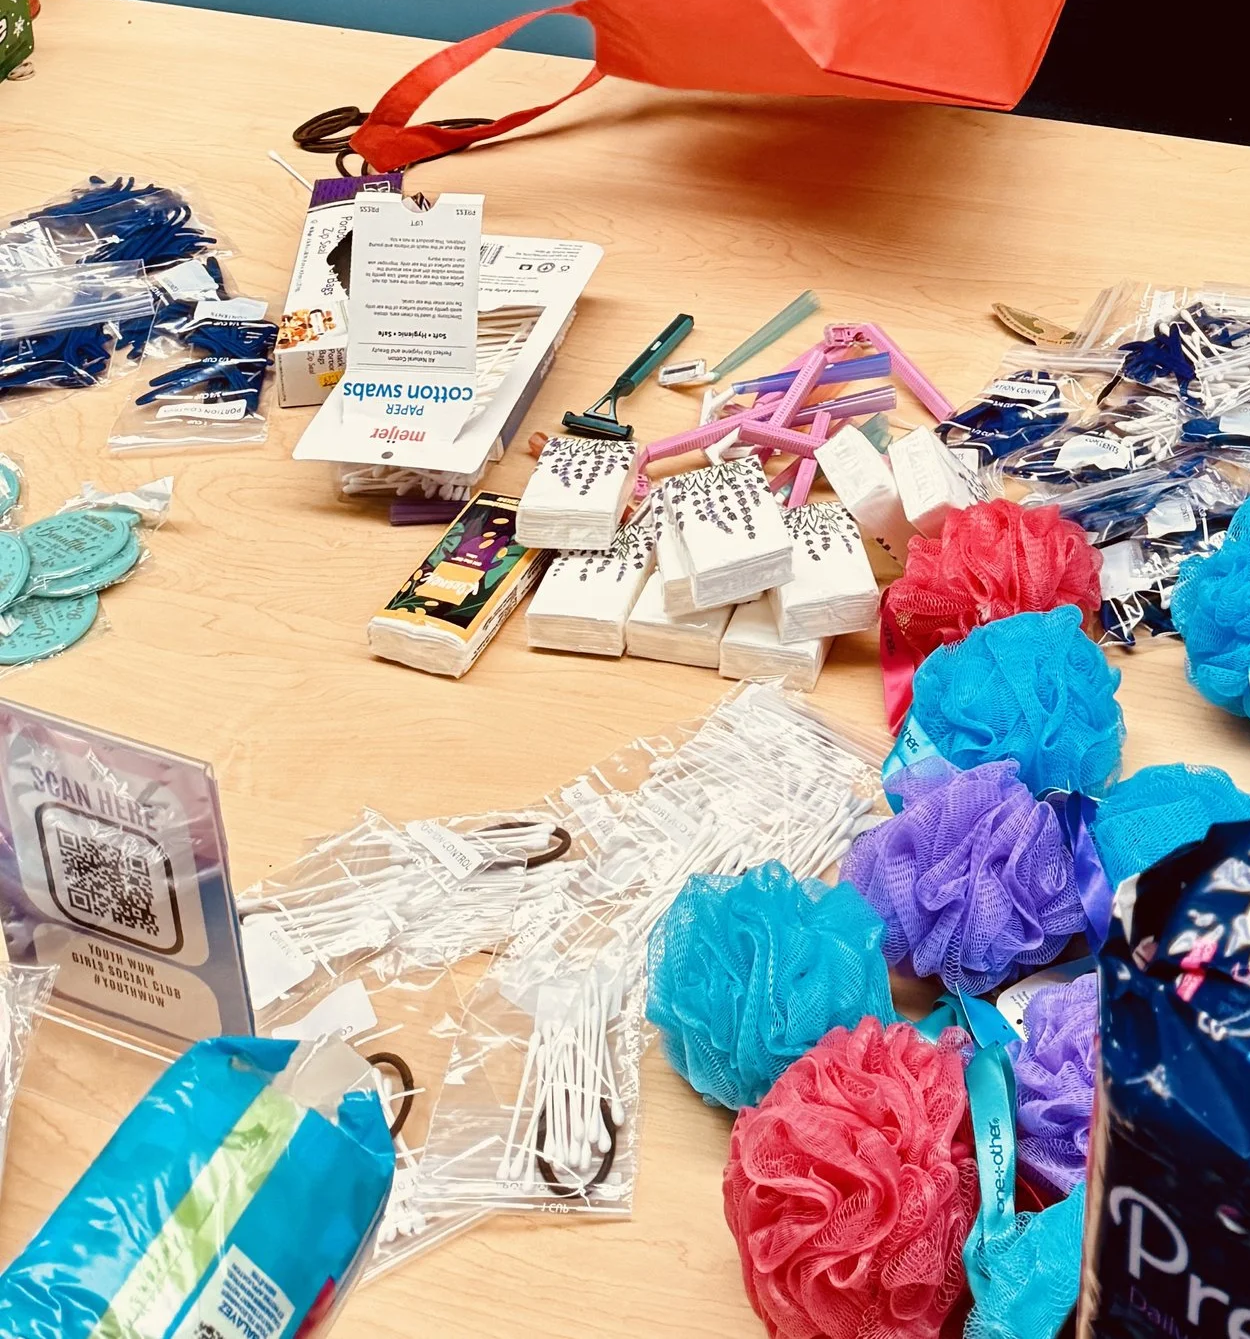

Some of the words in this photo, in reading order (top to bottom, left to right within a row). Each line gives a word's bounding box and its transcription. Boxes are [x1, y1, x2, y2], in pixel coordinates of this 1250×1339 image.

[320, 228, 334, 240] Zip
[318, 350, 326, 365] Bags
[336, 348, 345, 368] Snack
[343, 382, 402, 402] swabs
[408, 384, 473, 404] cotton
[386, 404, 424, 416] PAPER
[369, 426, 426, 443] meijer
[30, 765, 94, 811] SCAN
[97, 786, 158, 832] HERE
[88, 942, 126, 966] YOUTH
[128, 957, 156, 978] WUW
[72, 951, 106, 974] GIRLS
[108, 962, 150, 988] SOCIAL
[152, 978, 182, 1000] CLUB
[94, 974, 166, 1009] #YOUTHWUW
[997, 1122, 1006, 1214] one+other
